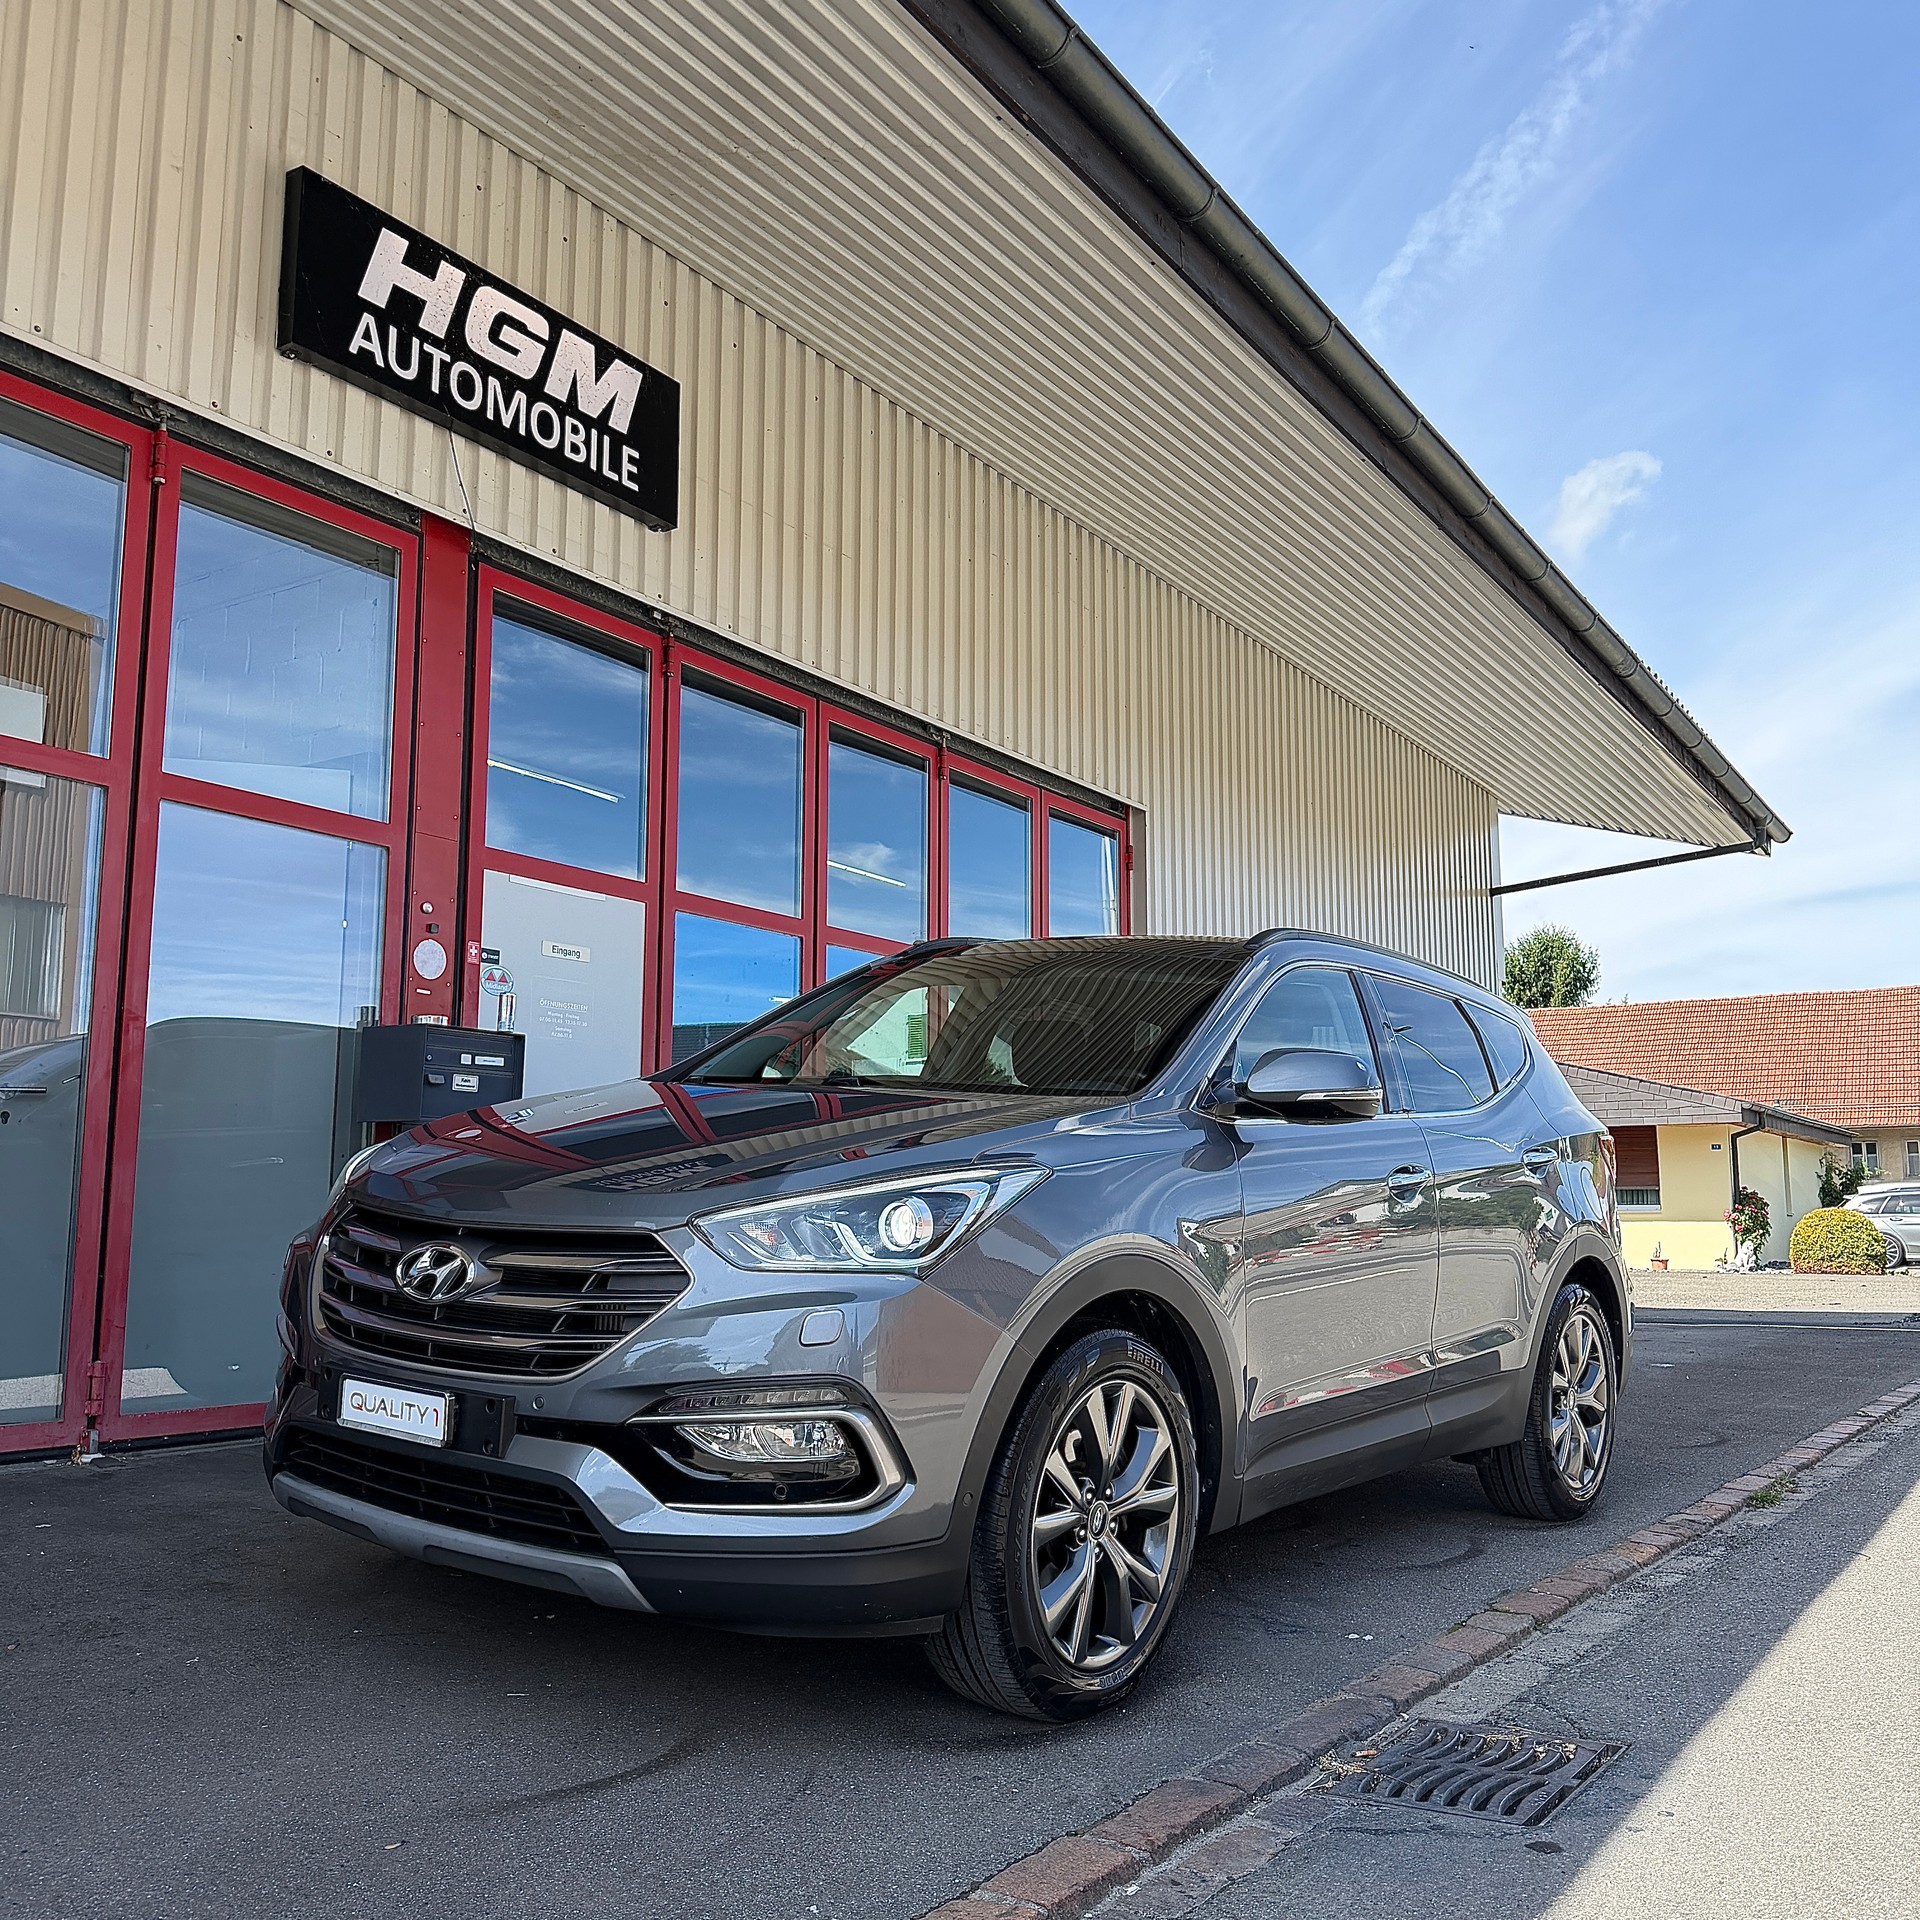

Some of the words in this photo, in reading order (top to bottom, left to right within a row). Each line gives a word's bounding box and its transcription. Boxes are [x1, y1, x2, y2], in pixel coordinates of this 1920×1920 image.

[358, 228, 643, 434] HGM
[349, 312, 640, 492] AUTOMOBILE
[551, 944, 581, 960] Eingang
[539, 997, 588, 1012] ÖFFNUNGSZEITEN
